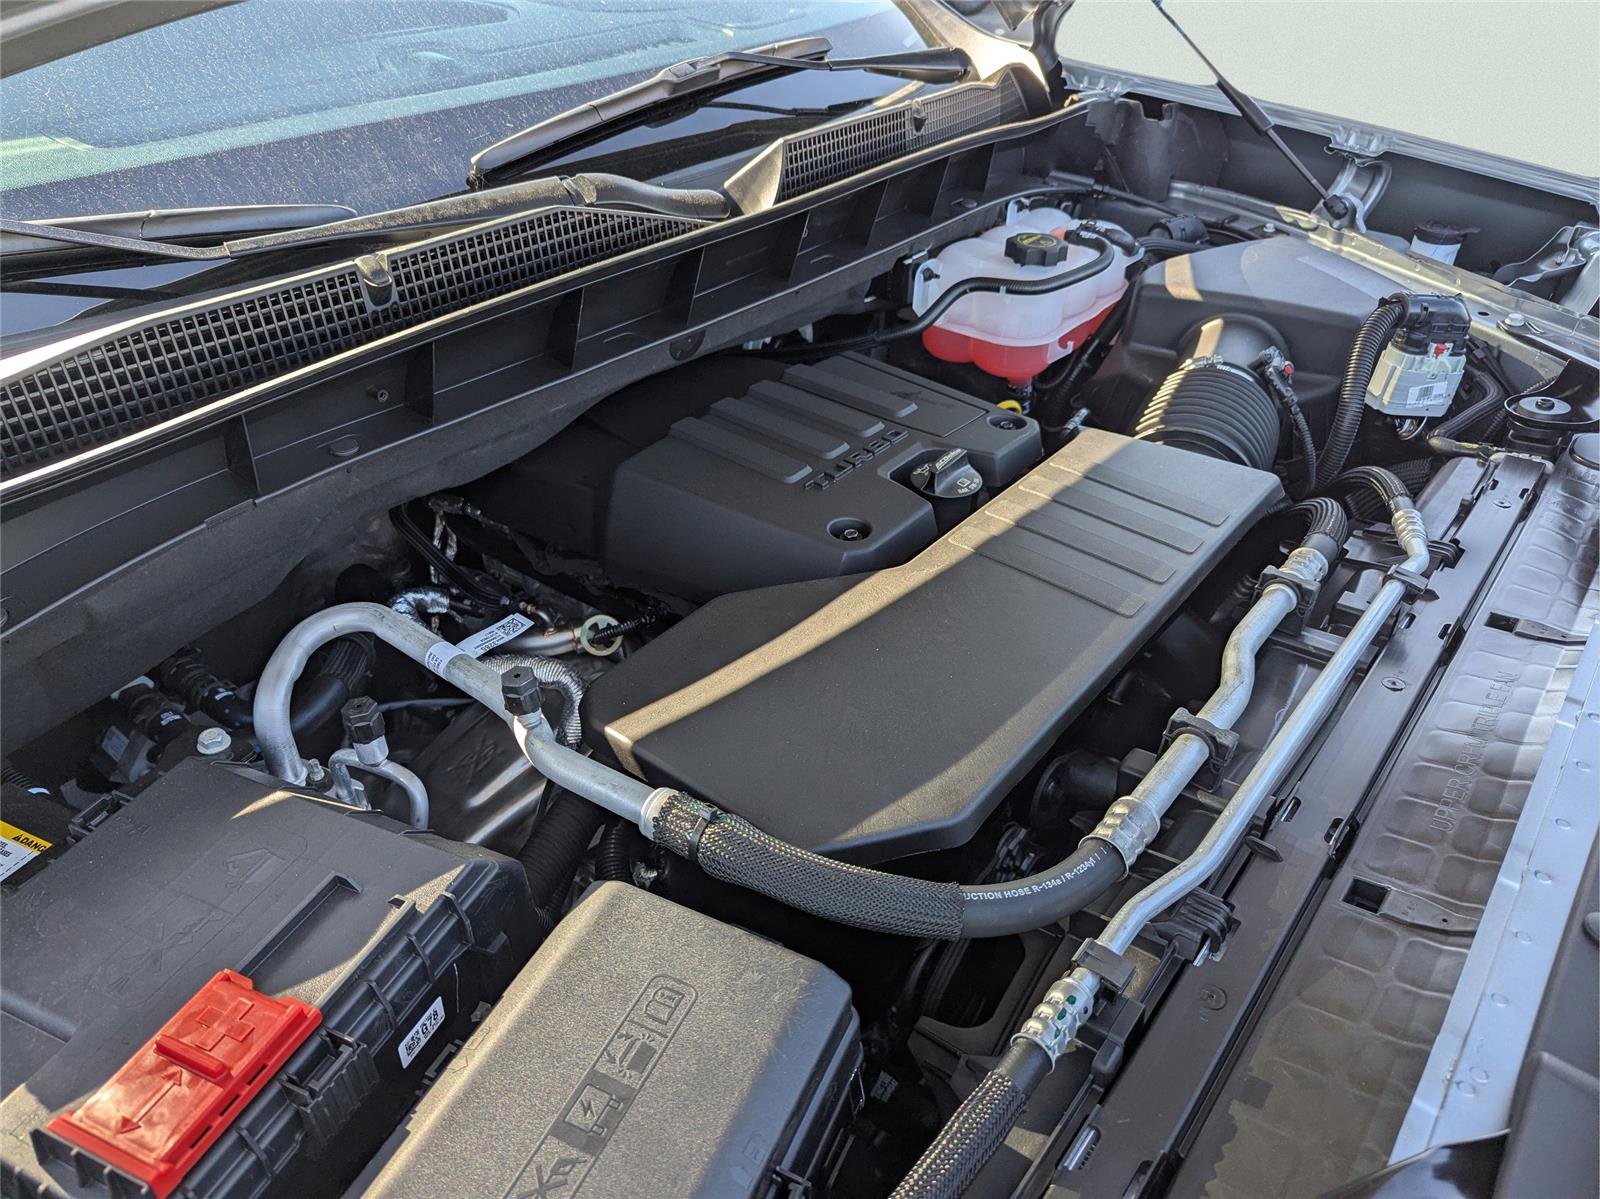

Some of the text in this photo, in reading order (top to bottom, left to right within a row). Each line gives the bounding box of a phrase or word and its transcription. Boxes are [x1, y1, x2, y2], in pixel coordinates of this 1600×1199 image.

[1428, 777, 1472, 833] UPPER
[960, 891, 1003, 900] UCTION
[1005, 886, 1032, 898] HOSE
[1031, 879, 1062, 892] R-134a
[1065, 857, 1096, 879] R-1234yf
